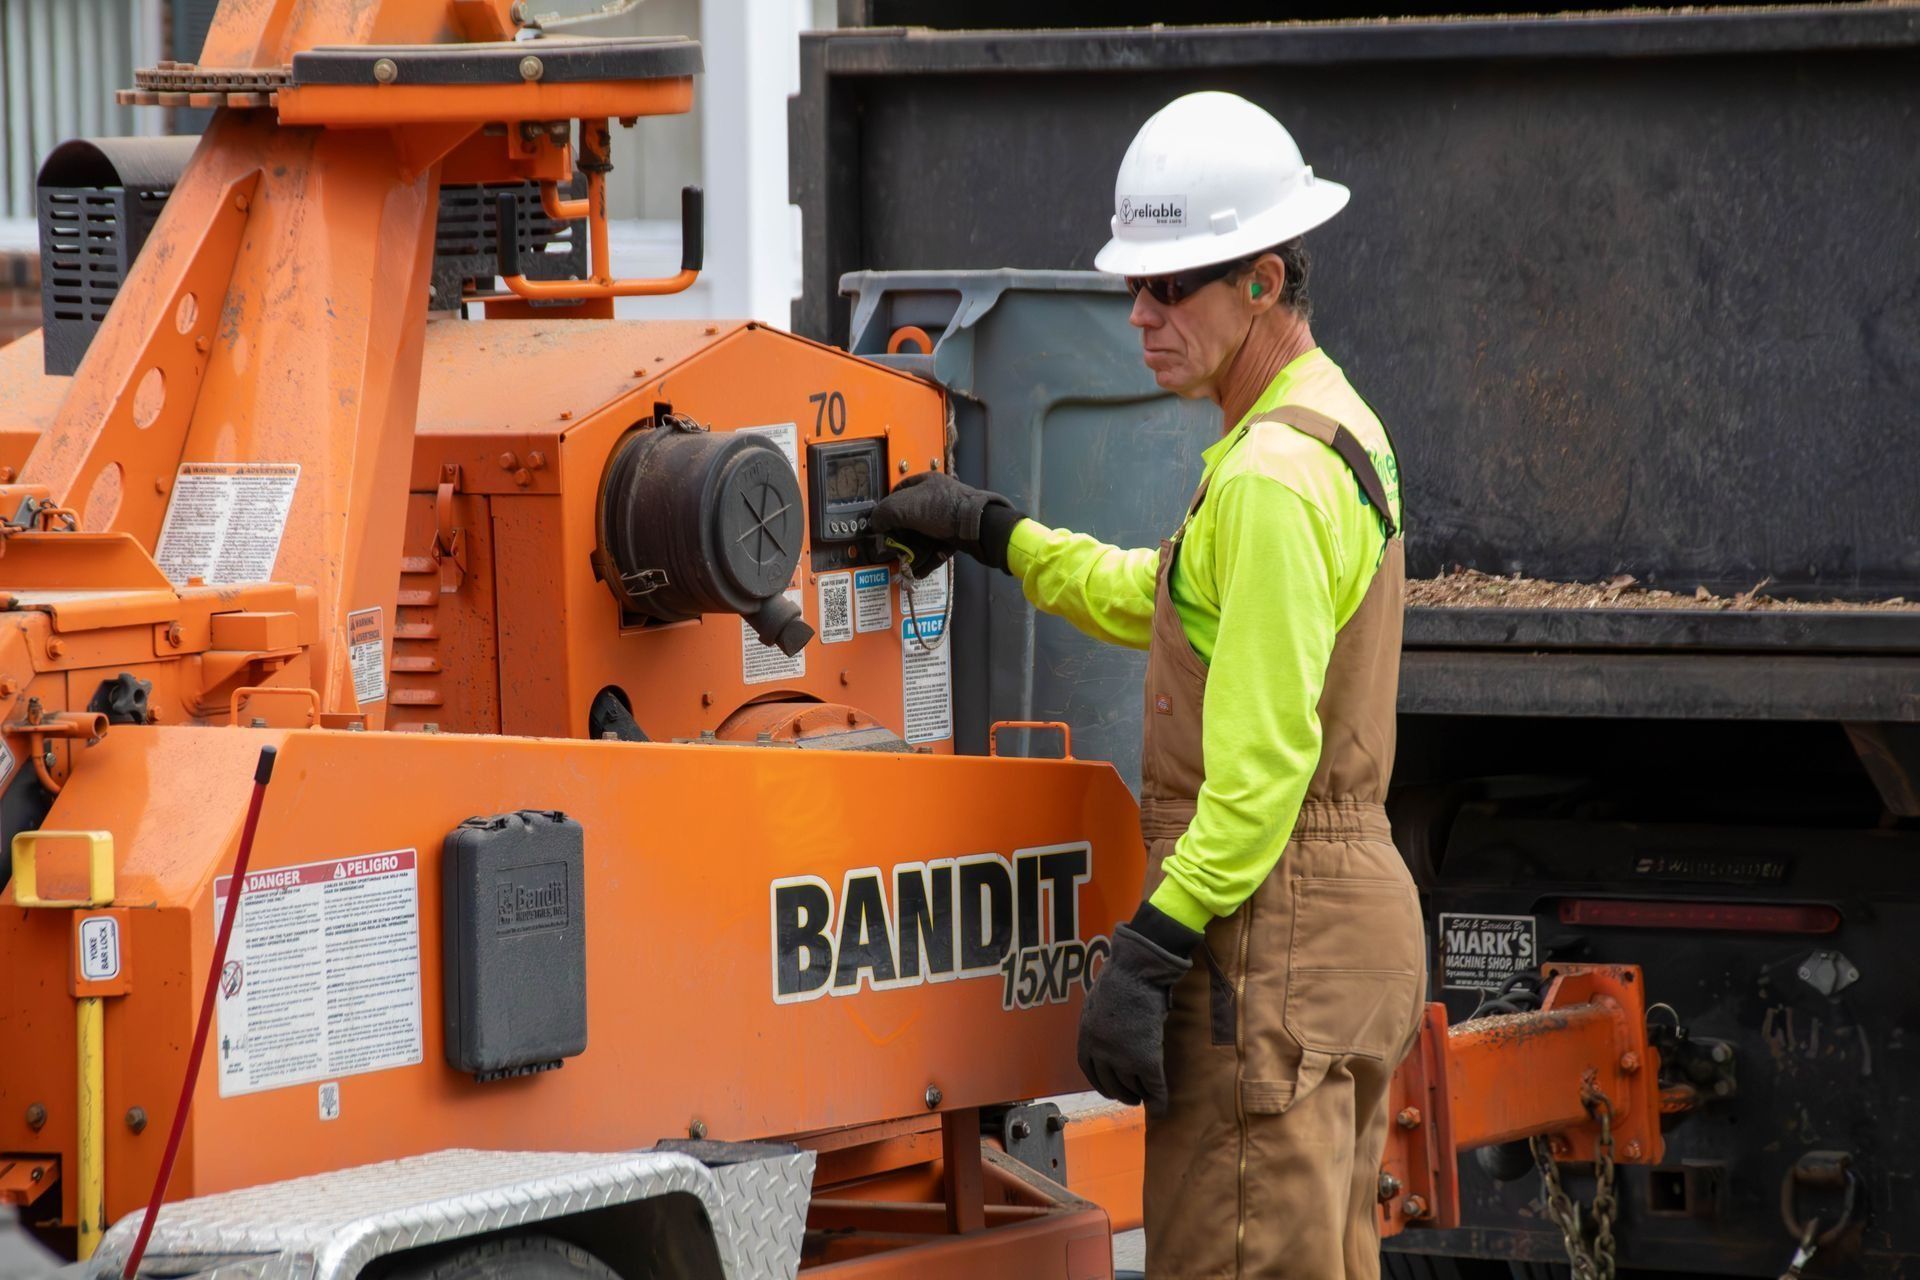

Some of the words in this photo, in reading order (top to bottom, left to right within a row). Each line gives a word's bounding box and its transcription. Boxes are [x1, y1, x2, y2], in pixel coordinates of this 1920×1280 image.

[1134, 203, 1182, 218] reliable
[809, 391, 846, 438] 70
[859, 573, 886, 585] NOTICE
[347, 856, 399, 876] PELIGRO
[249, 870, 300, 891] DANGER
[515, 880, 562, 911] Bandit
[773, 846, 1090, 1000] BANDIT
[90, 937, 98, 960] YOKE
[100, 926, 108, 950] LOCK
[1446, 929, 1532, 957] MARK'S
[101, 951, 109, 969] BAR
[1445, 955, 1487, 969] MACHINE
[1487, 956, 1514, 971] SHOP,
